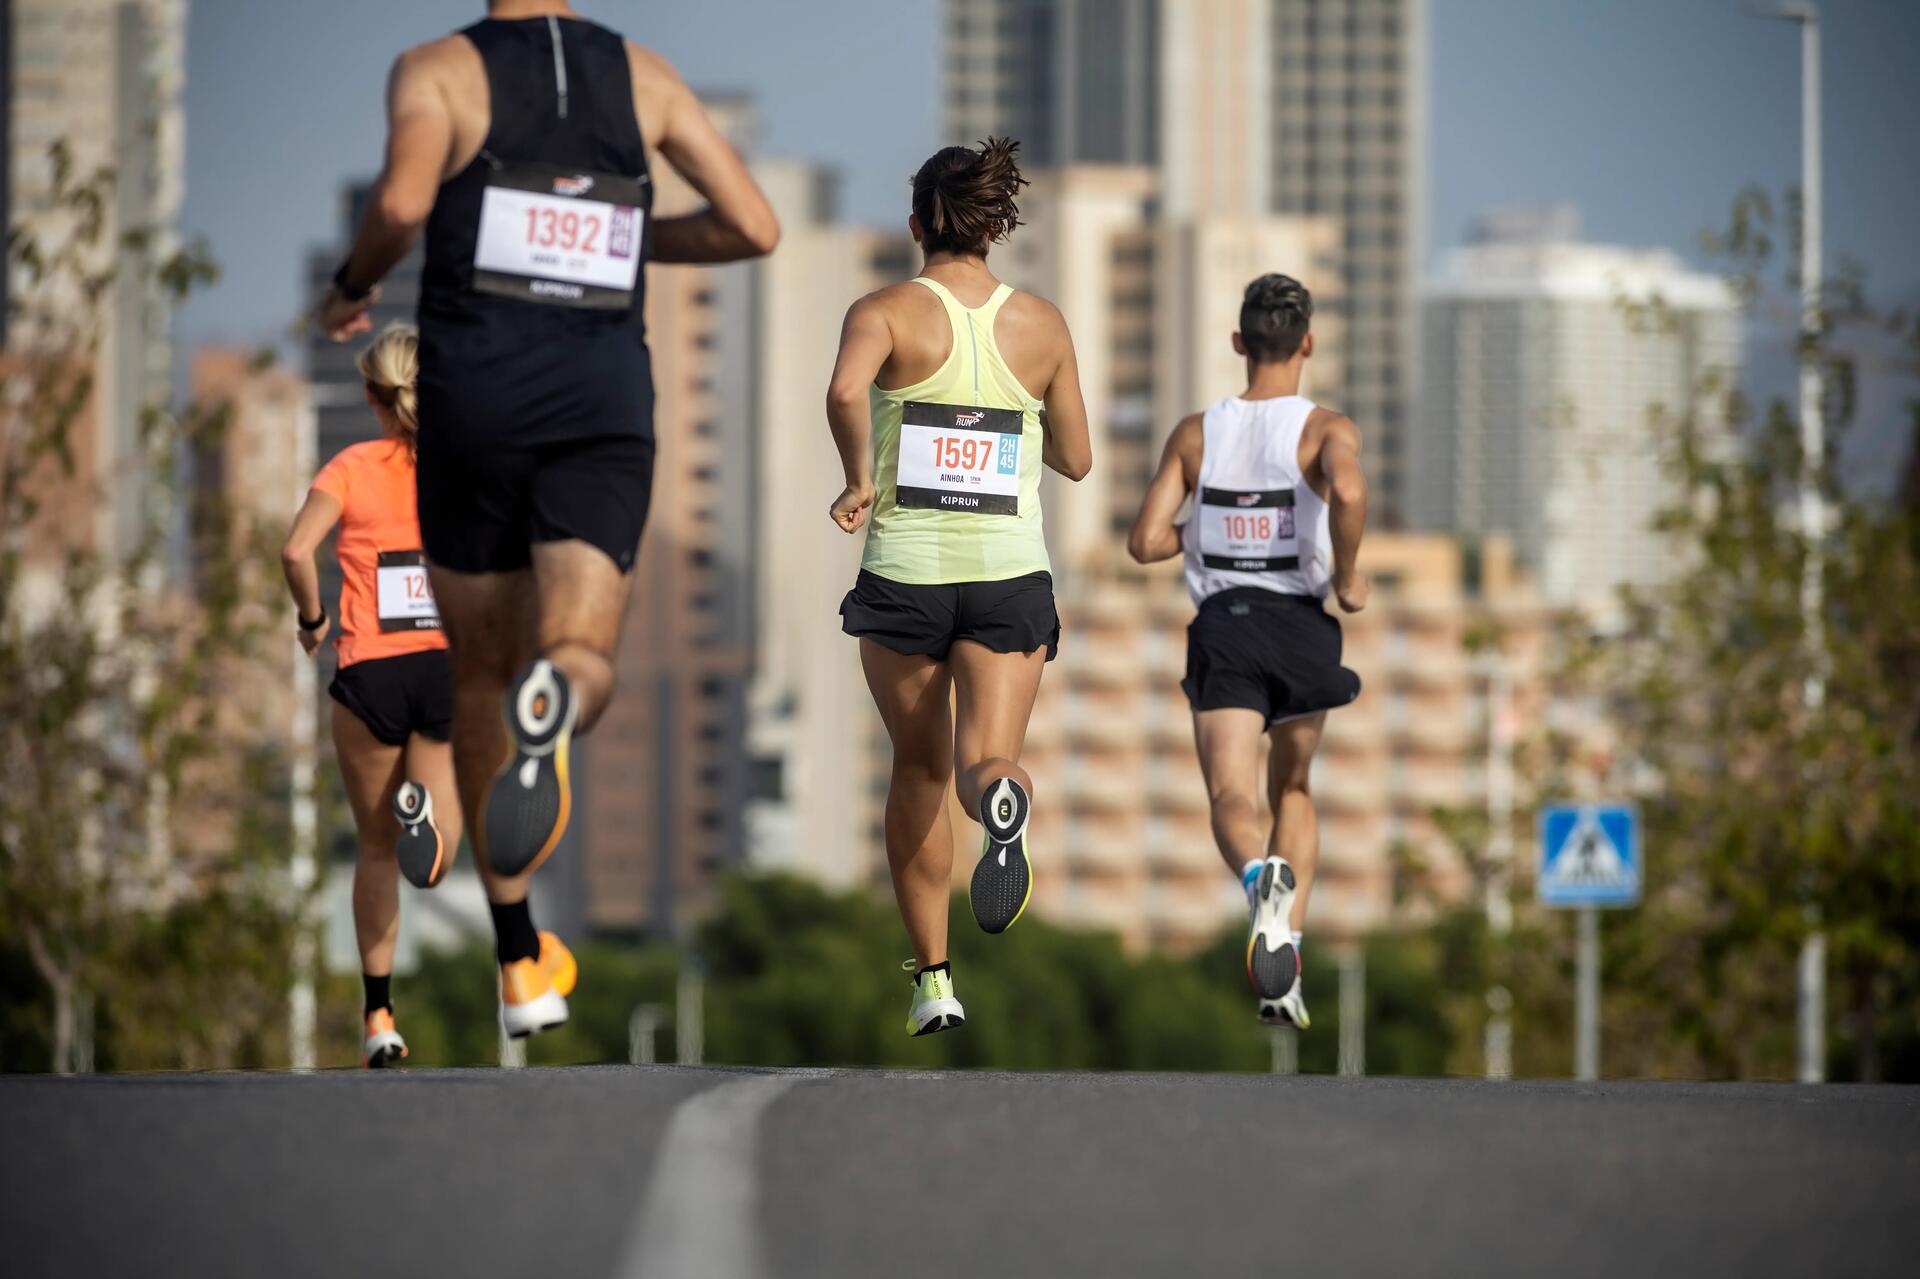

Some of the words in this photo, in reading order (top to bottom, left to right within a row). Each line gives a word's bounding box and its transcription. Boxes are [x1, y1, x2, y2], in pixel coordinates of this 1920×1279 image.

[525, 207, 601, 254] 1392
[1000, 438, 1015, 453] 2H
[933, 437, 993, 471] 1597
[999, 454, 1014, 469] 45
[940, 473, 964, 483] AINHOA
[941, 495, 979, 507] KIPRUN
[1223, 515, 1271, 540] 1018
